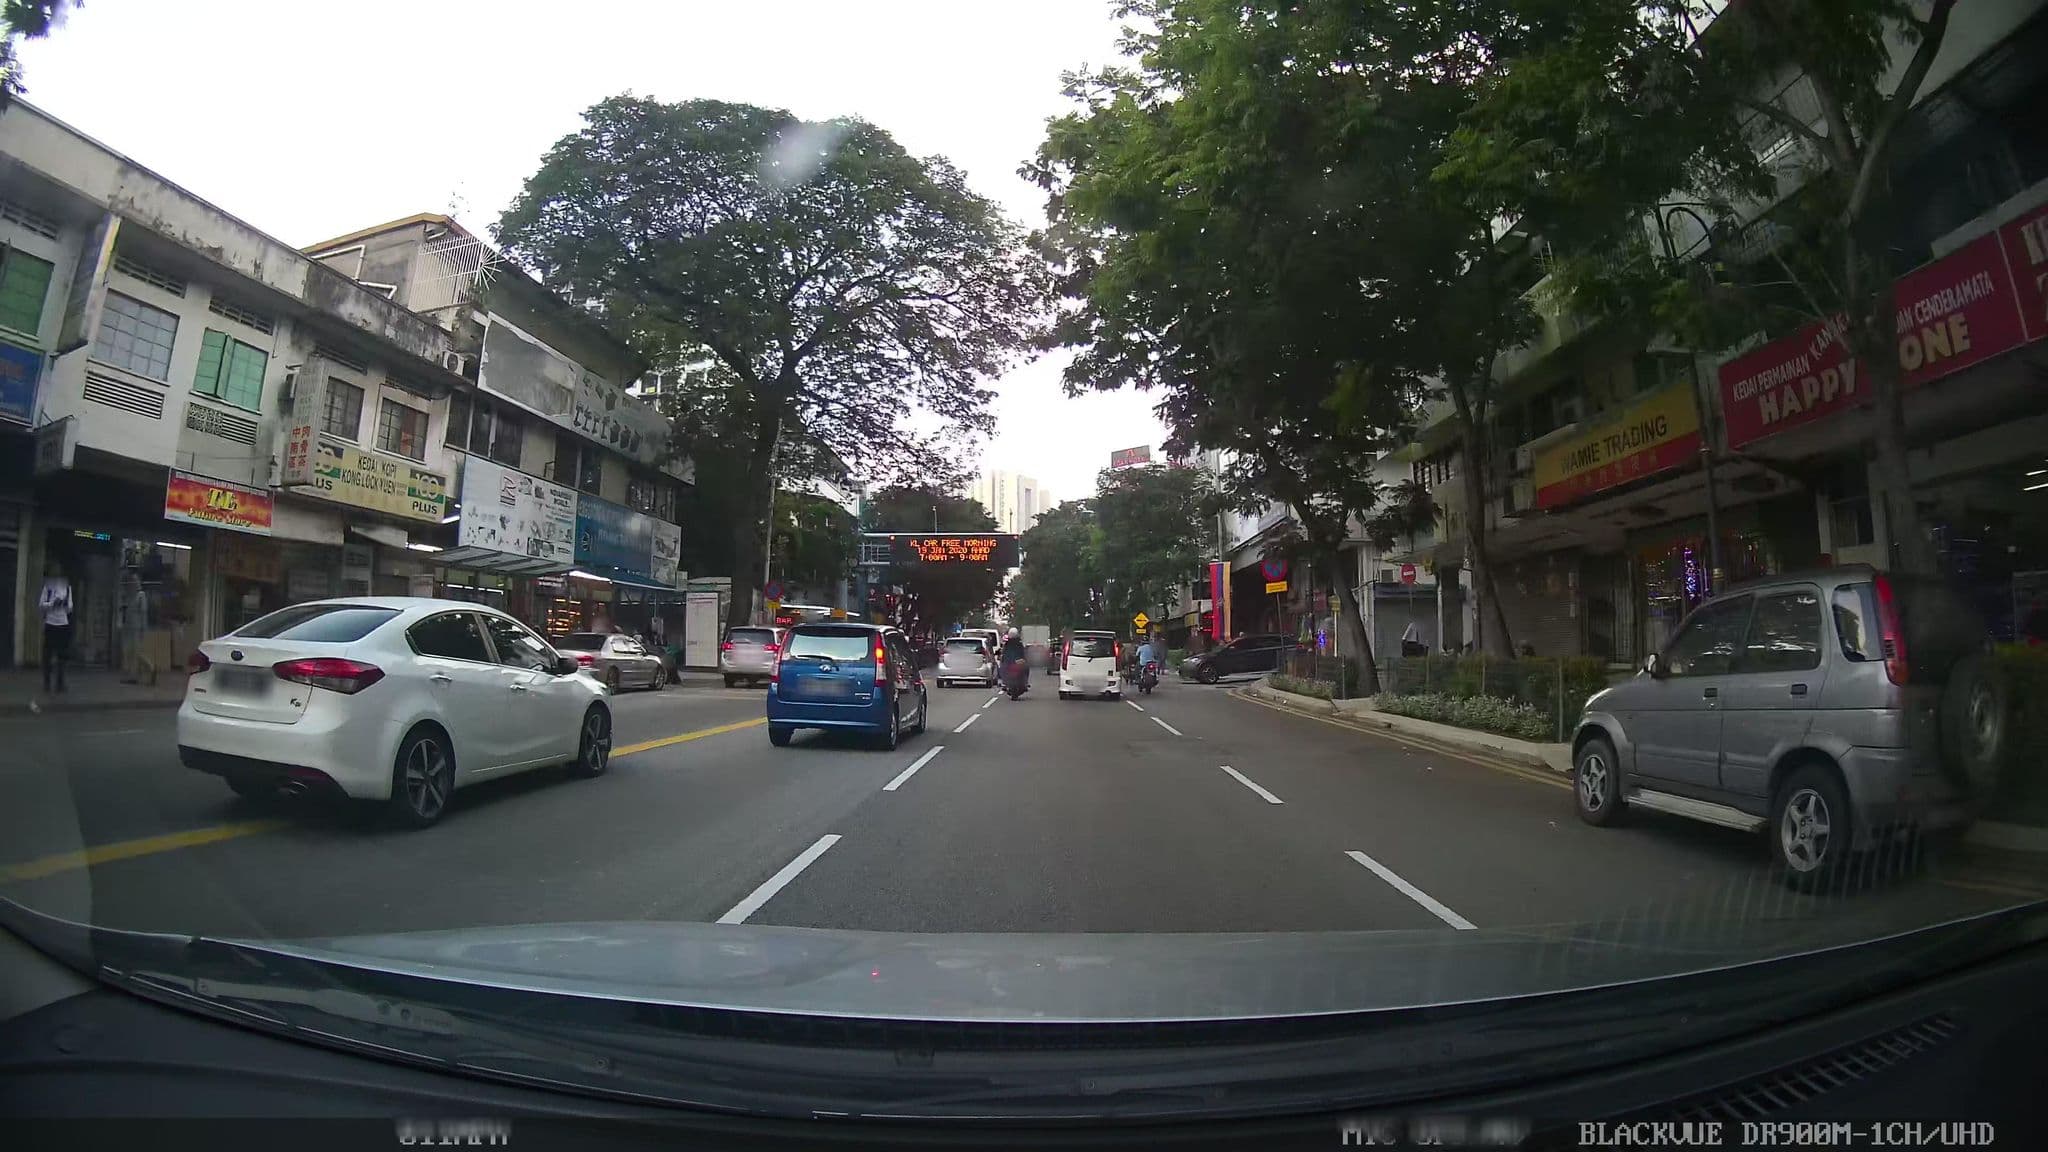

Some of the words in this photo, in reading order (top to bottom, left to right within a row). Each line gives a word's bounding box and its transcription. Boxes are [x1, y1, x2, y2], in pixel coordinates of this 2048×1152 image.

[1732, 377, 1759, 402] KEDAI
[1758, 354, 1810, 391] PERMAINAN
[1914, 270, 1995, 324] CENDERAMATA
[1758, 357, 1856, 425] HAPPY
[1899, 312, 1971, 371] ONE
[1603, 415, 1668, 457] TRADING
[357, 455, 378, 473] KEDAI
[382, 461, 397, 478] KOPI
[315, 477, 333, 491] US
[341, 469, 361, 487] KONG
[412, 501, 438, 515] PLUS
[923, 539, 938, 547] CAR
[963, 539, 997, 547] MORNING
